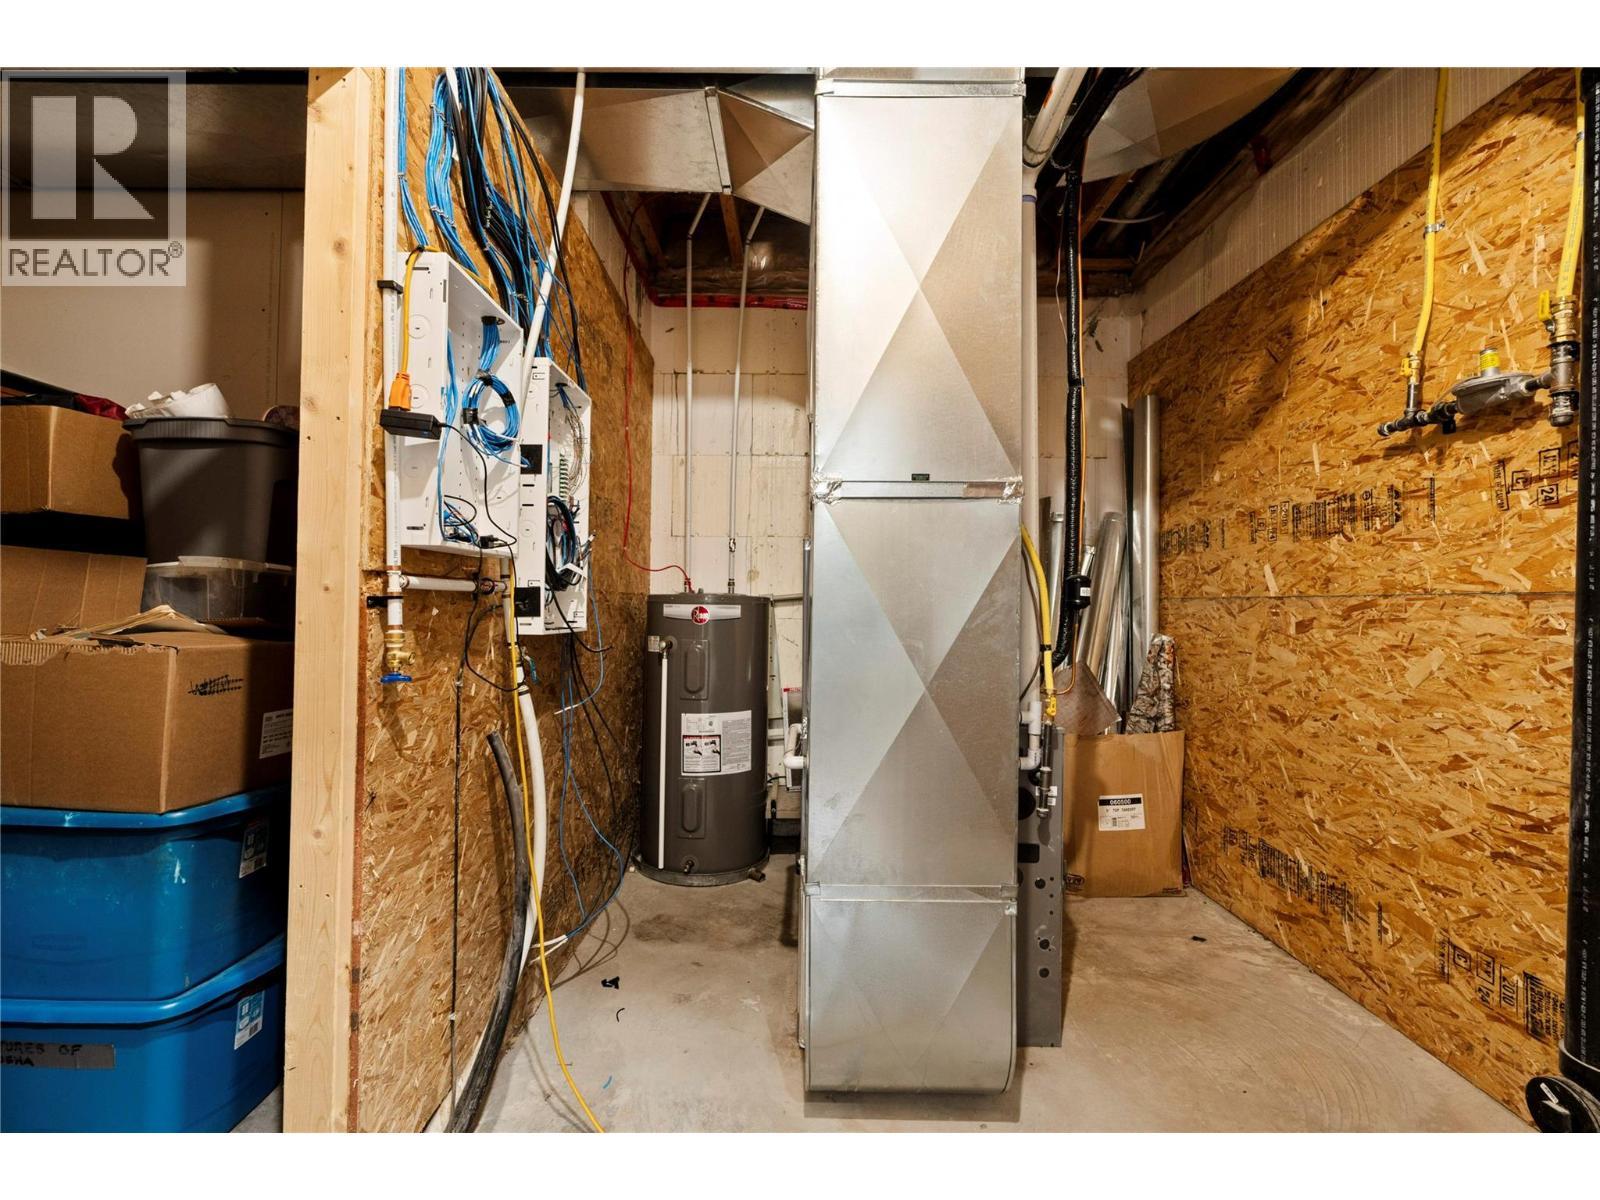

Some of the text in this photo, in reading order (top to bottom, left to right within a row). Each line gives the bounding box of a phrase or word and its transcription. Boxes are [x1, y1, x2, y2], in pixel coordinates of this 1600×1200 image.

[1540, 487, 1555, 502] 24
[1456, 953, 1468, 964] C
[1502, 976, 1517, 1008] 2010
[58, 1044, 83, 1056] OF
